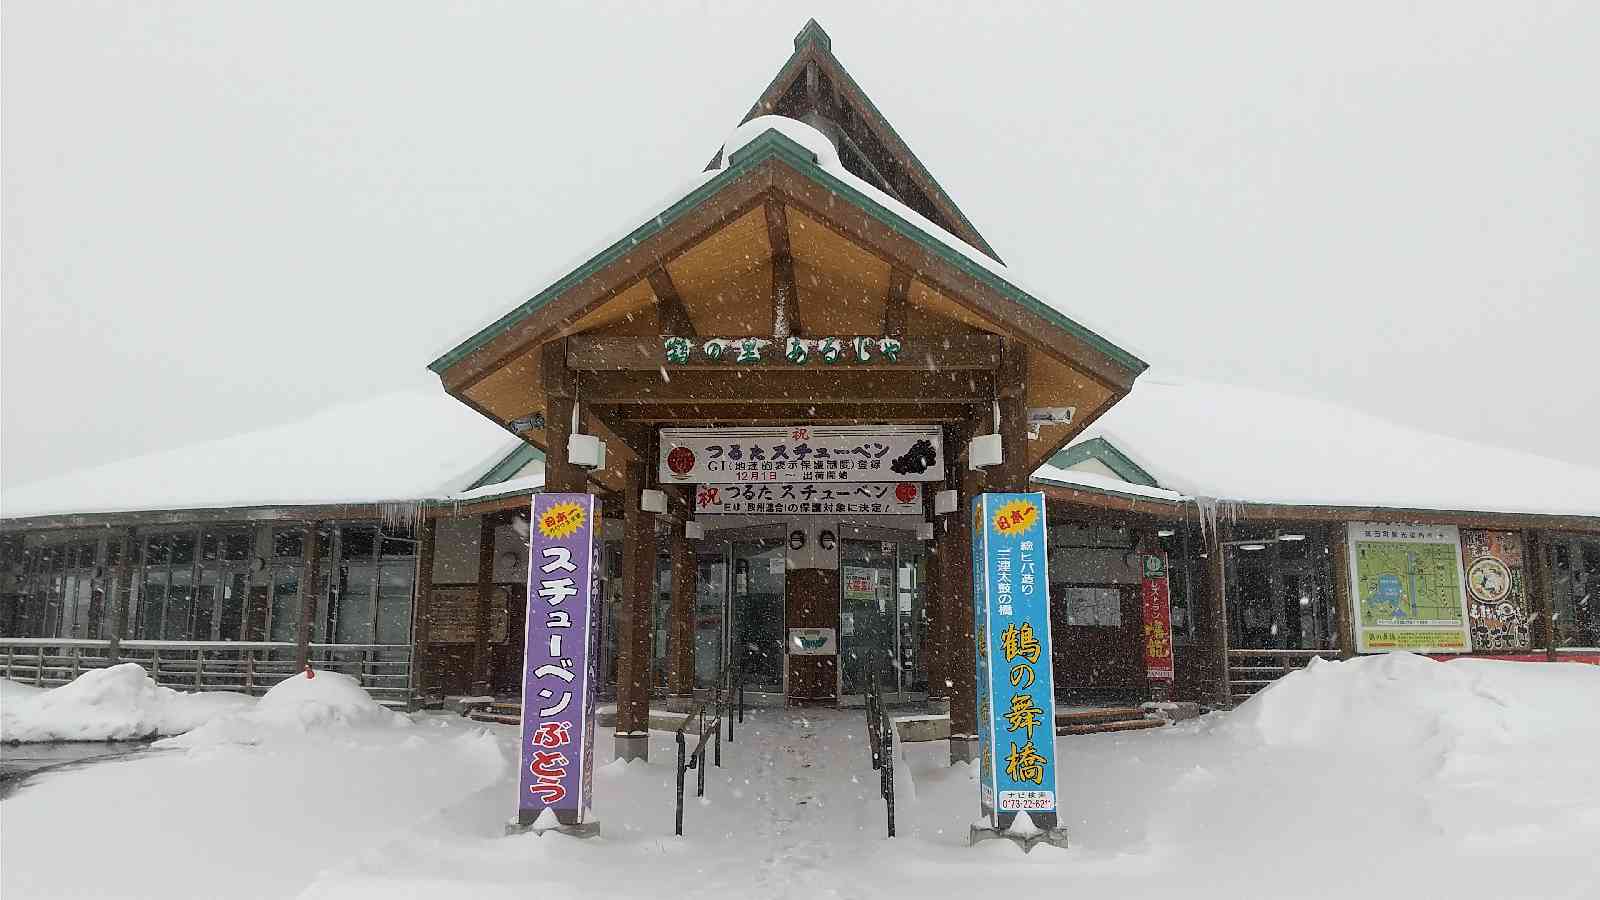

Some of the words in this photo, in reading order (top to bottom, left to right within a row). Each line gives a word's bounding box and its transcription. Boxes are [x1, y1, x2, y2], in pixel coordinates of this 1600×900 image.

[791, 427, 810, 441] 祝
[696, 484, 722, 509] 祝
[1000, 622, 1047, 786] 鶴の舞橋
